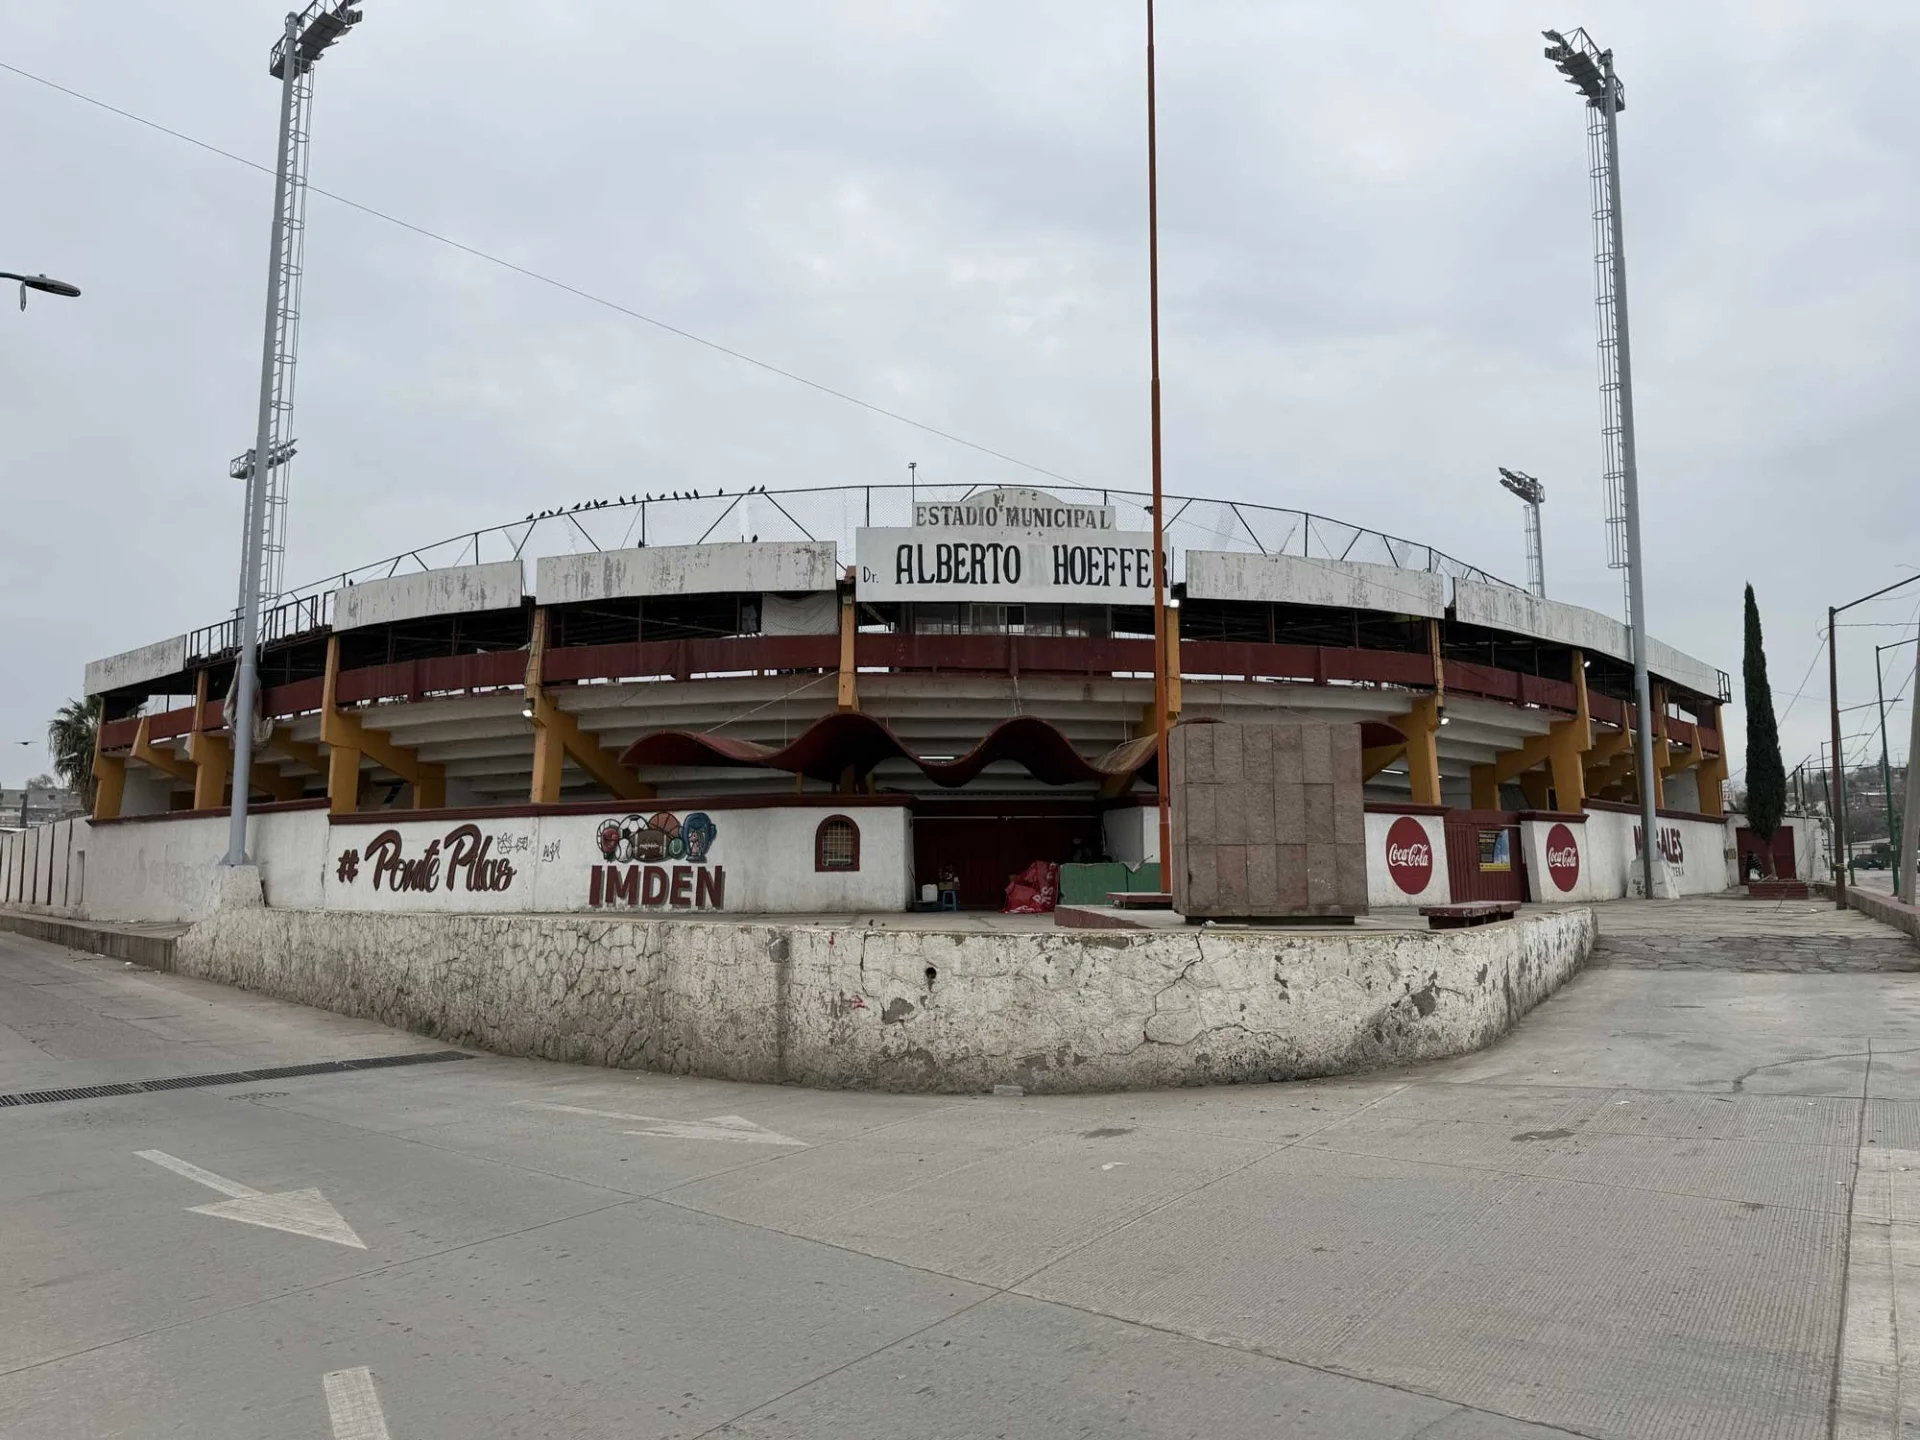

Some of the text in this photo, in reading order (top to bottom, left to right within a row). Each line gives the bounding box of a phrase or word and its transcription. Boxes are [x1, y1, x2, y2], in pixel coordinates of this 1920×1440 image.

[916, 505, 1111, 530] ESTADIO MUNICIPAL
[863, 566, 879, 583] Dr.
[895, 543, 1021, 584] ALBERTO
[588, 865, 726, 910] IMDEN
